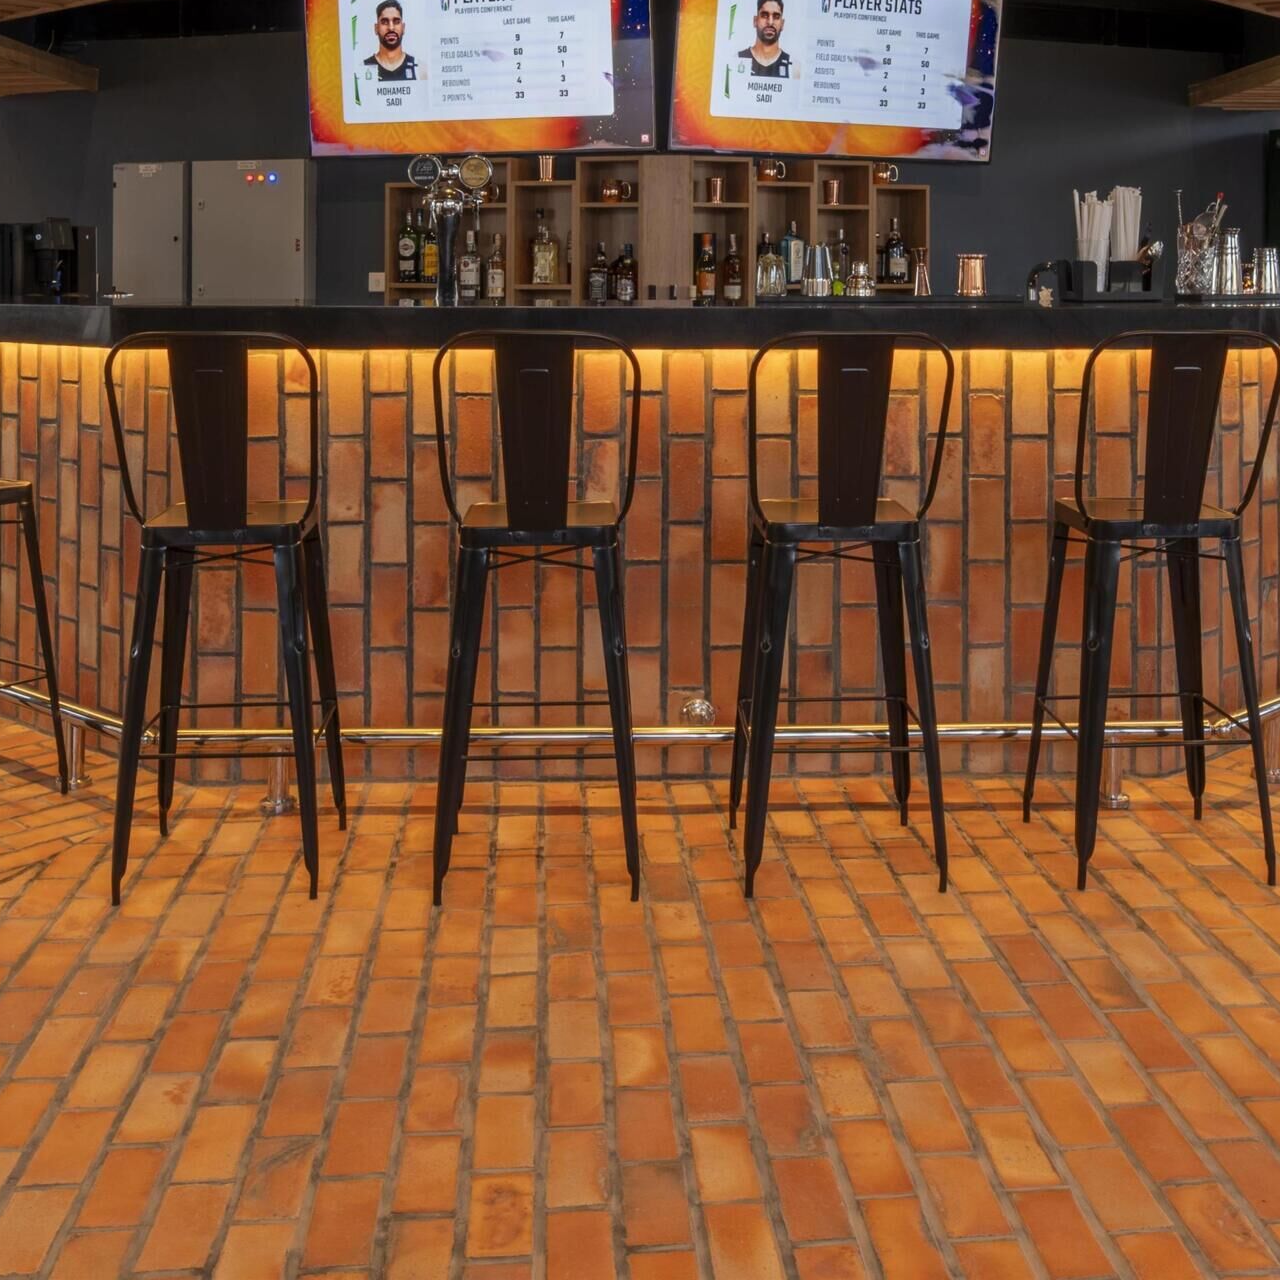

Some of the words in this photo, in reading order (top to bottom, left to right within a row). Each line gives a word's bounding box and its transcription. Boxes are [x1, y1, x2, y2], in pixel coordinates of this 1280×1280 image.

[559, 31, 565, 40] 7
[513, 47, 523, 56] 60
[557, 45, 568, 54] 50
[924, 47, 929, 56] 7
[516, 62, 522, 70] 2
[882, 57, 892, 66] 60
[920, 60, 930, 69] 50
[516, 76, 522, 84] 4
[883, 71, 889, 80] 2
[376, 86, 411, 97] MOHAMED
[747, 82, 783, 93] MOHAMED
[882, 85, 888, 93] 4
[515, 91, 525, 100] 33
[558, 89, 569, 98] 33
[756, 93, 773, 104] SADI
[386, 98, 402, 107] SADI
[879, 99, 888, 108] 33
[917, 101, 927, 110] 33
